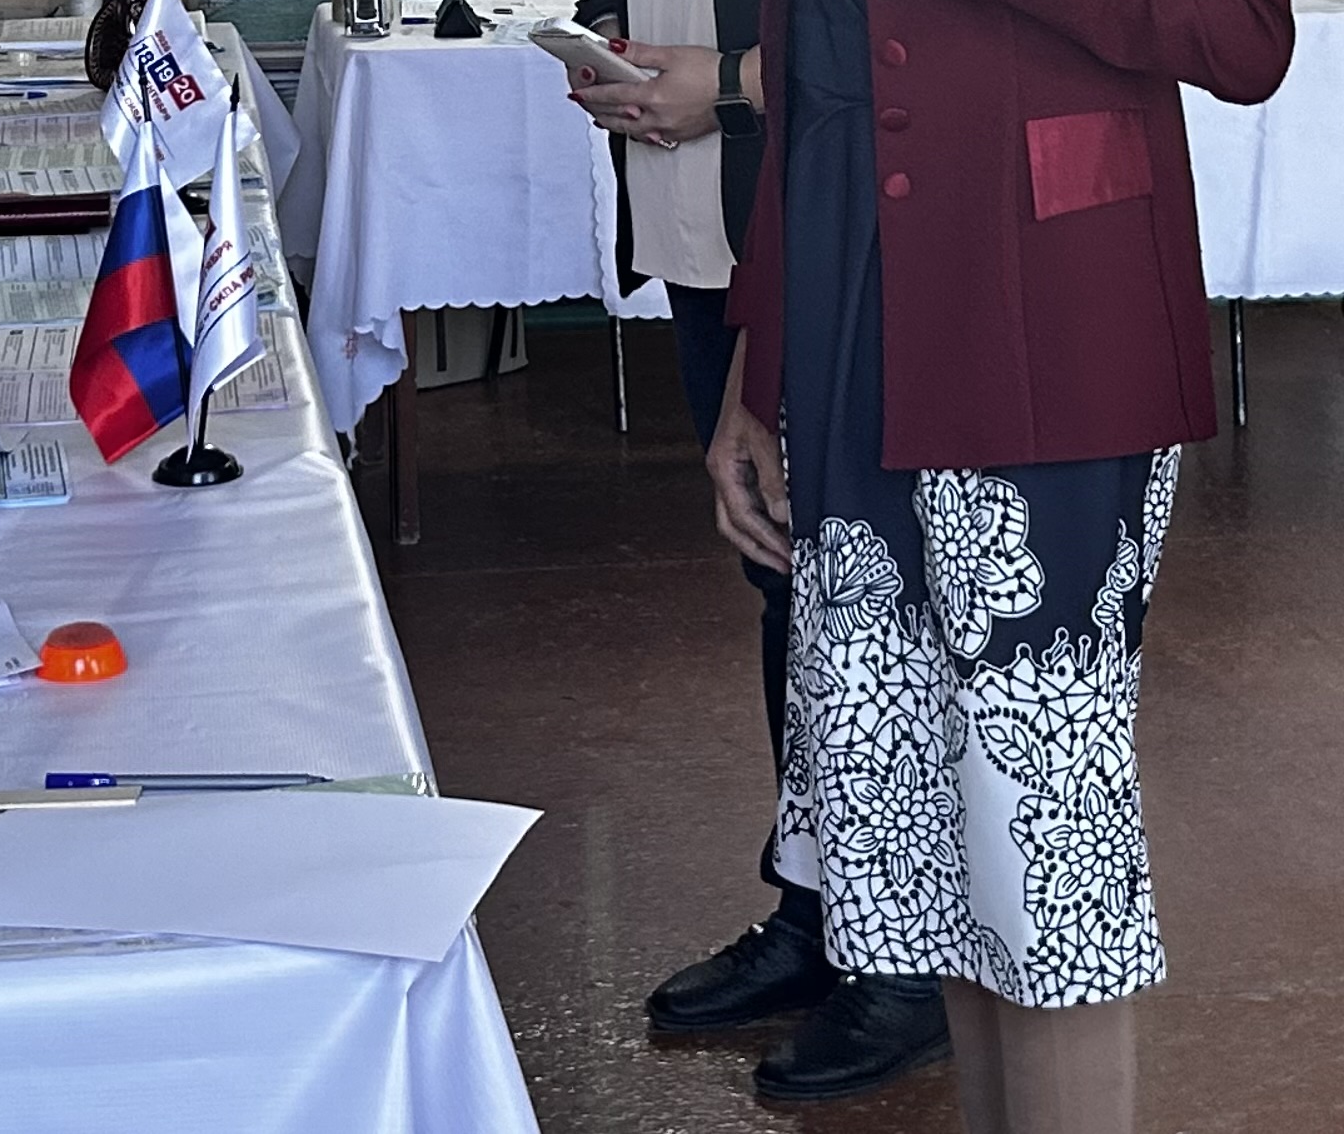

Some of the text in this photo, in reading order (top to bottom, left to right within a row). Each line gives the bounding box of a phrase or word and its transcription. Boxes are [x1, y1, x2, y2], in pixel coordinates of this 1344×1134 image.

[134, 43, 155, 70] 18
[154, 59, 175, 83] 19
[171, 78, 196, 104] 20
[208, 280, 242, 312] СИЛА
